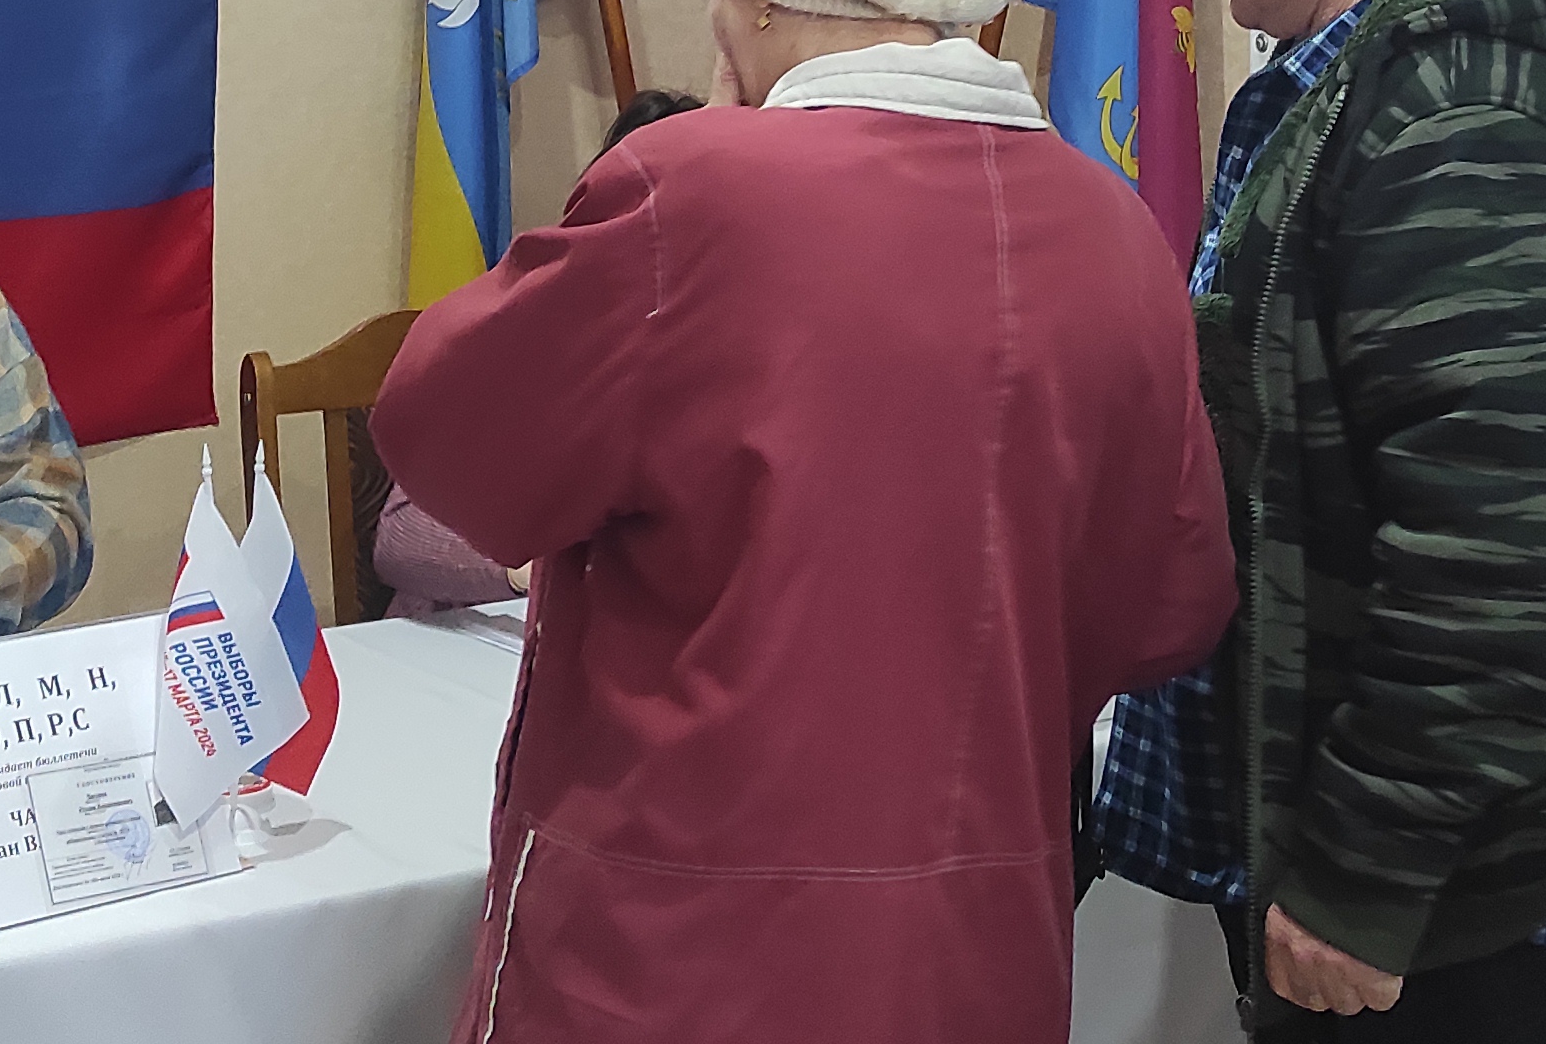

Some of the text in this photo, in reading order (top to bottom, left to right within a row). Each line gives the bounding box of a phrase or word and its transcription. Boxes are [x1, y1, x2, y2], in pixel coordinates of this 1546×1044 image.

[37, 674, 71, 700] М,
[86, 665, 116, 691] Н,
[169, 642, 219, 712] РОССИИ
[192, 636, 254, 746] ПРЕЗИДЕНТА
[217, 632, 262, 708] ВЫБОРЫ
[168, 683, 203, 727] МАРТА
[193, 727, 217, 758] 2024
[35, 747, 98, 768] бюллетени
